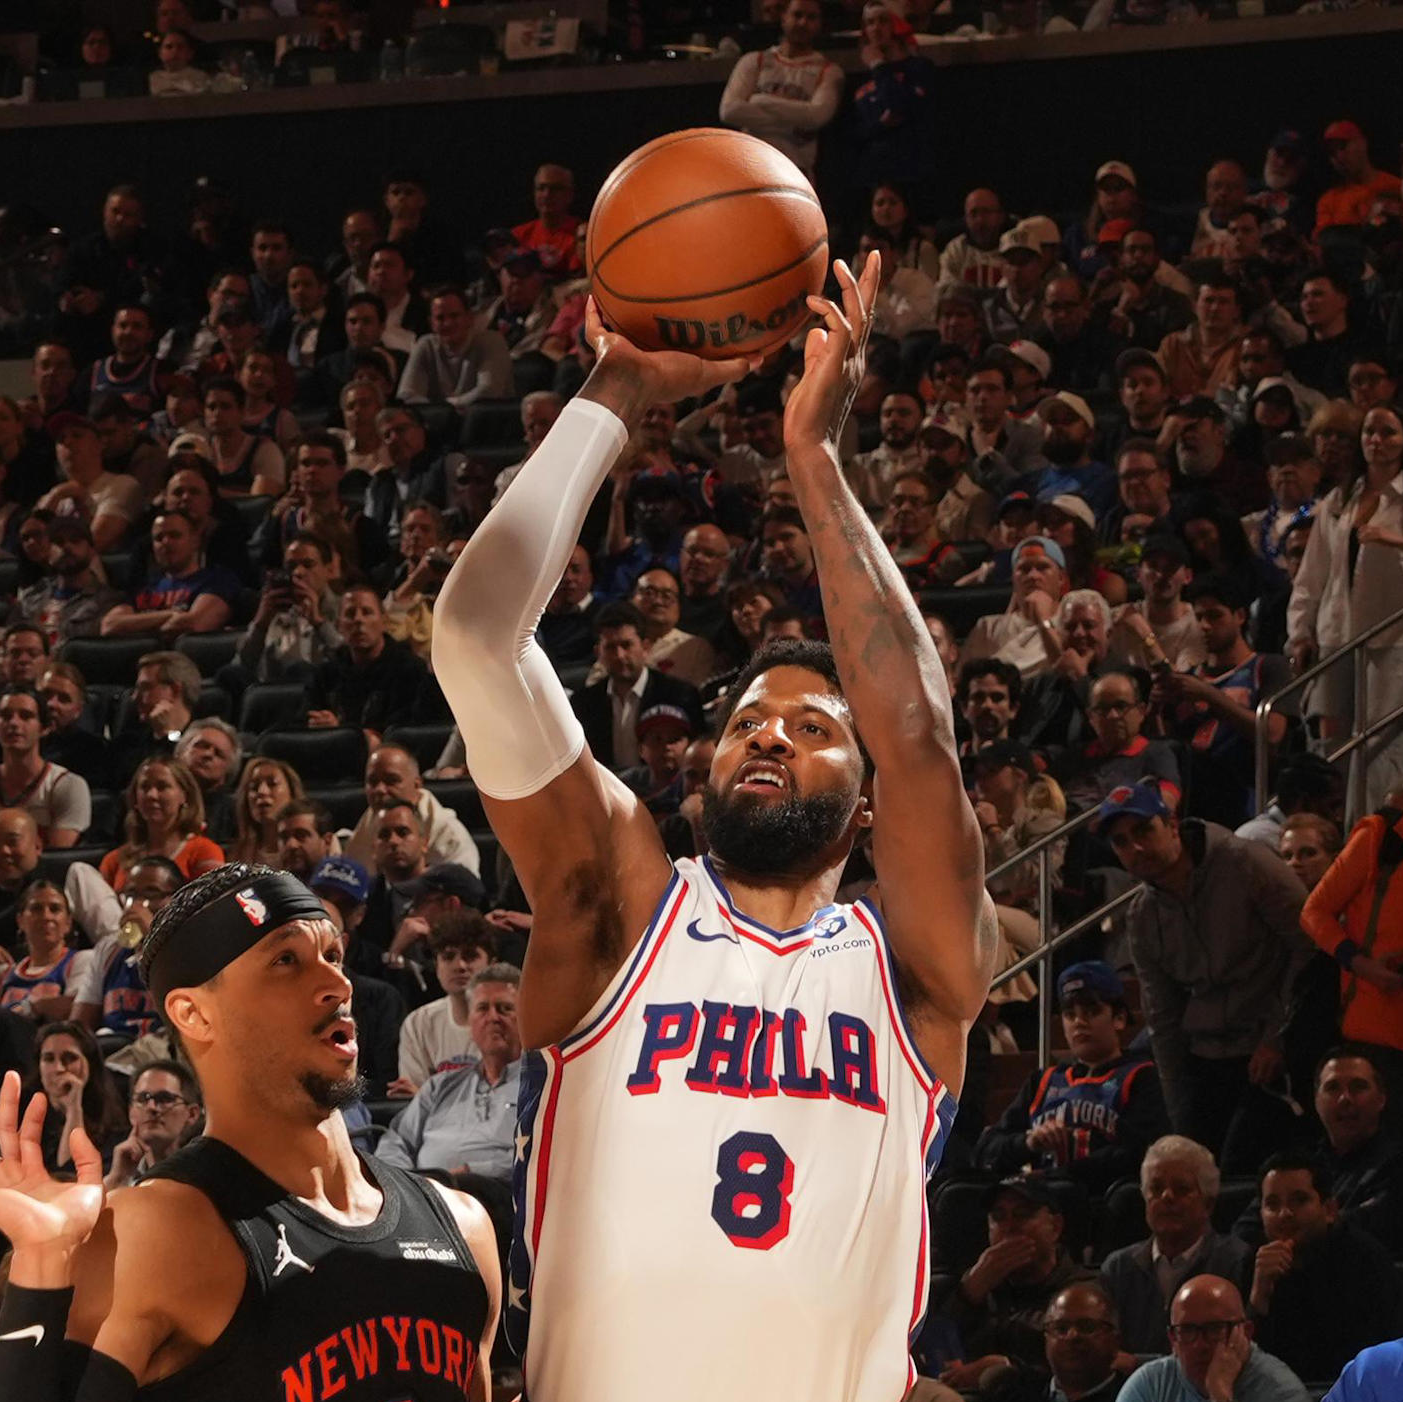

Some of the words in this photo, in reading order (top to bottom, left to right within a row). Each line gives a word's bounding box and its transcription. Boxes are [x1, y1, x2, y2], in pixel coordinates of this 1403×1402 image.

[653, 294, 805, 350] Wilson
[627, 1003, 886, 1116] PHILA
[1070, 1099, 1119, 1137] YORK
[711, 1131, 795, 1250] 8
